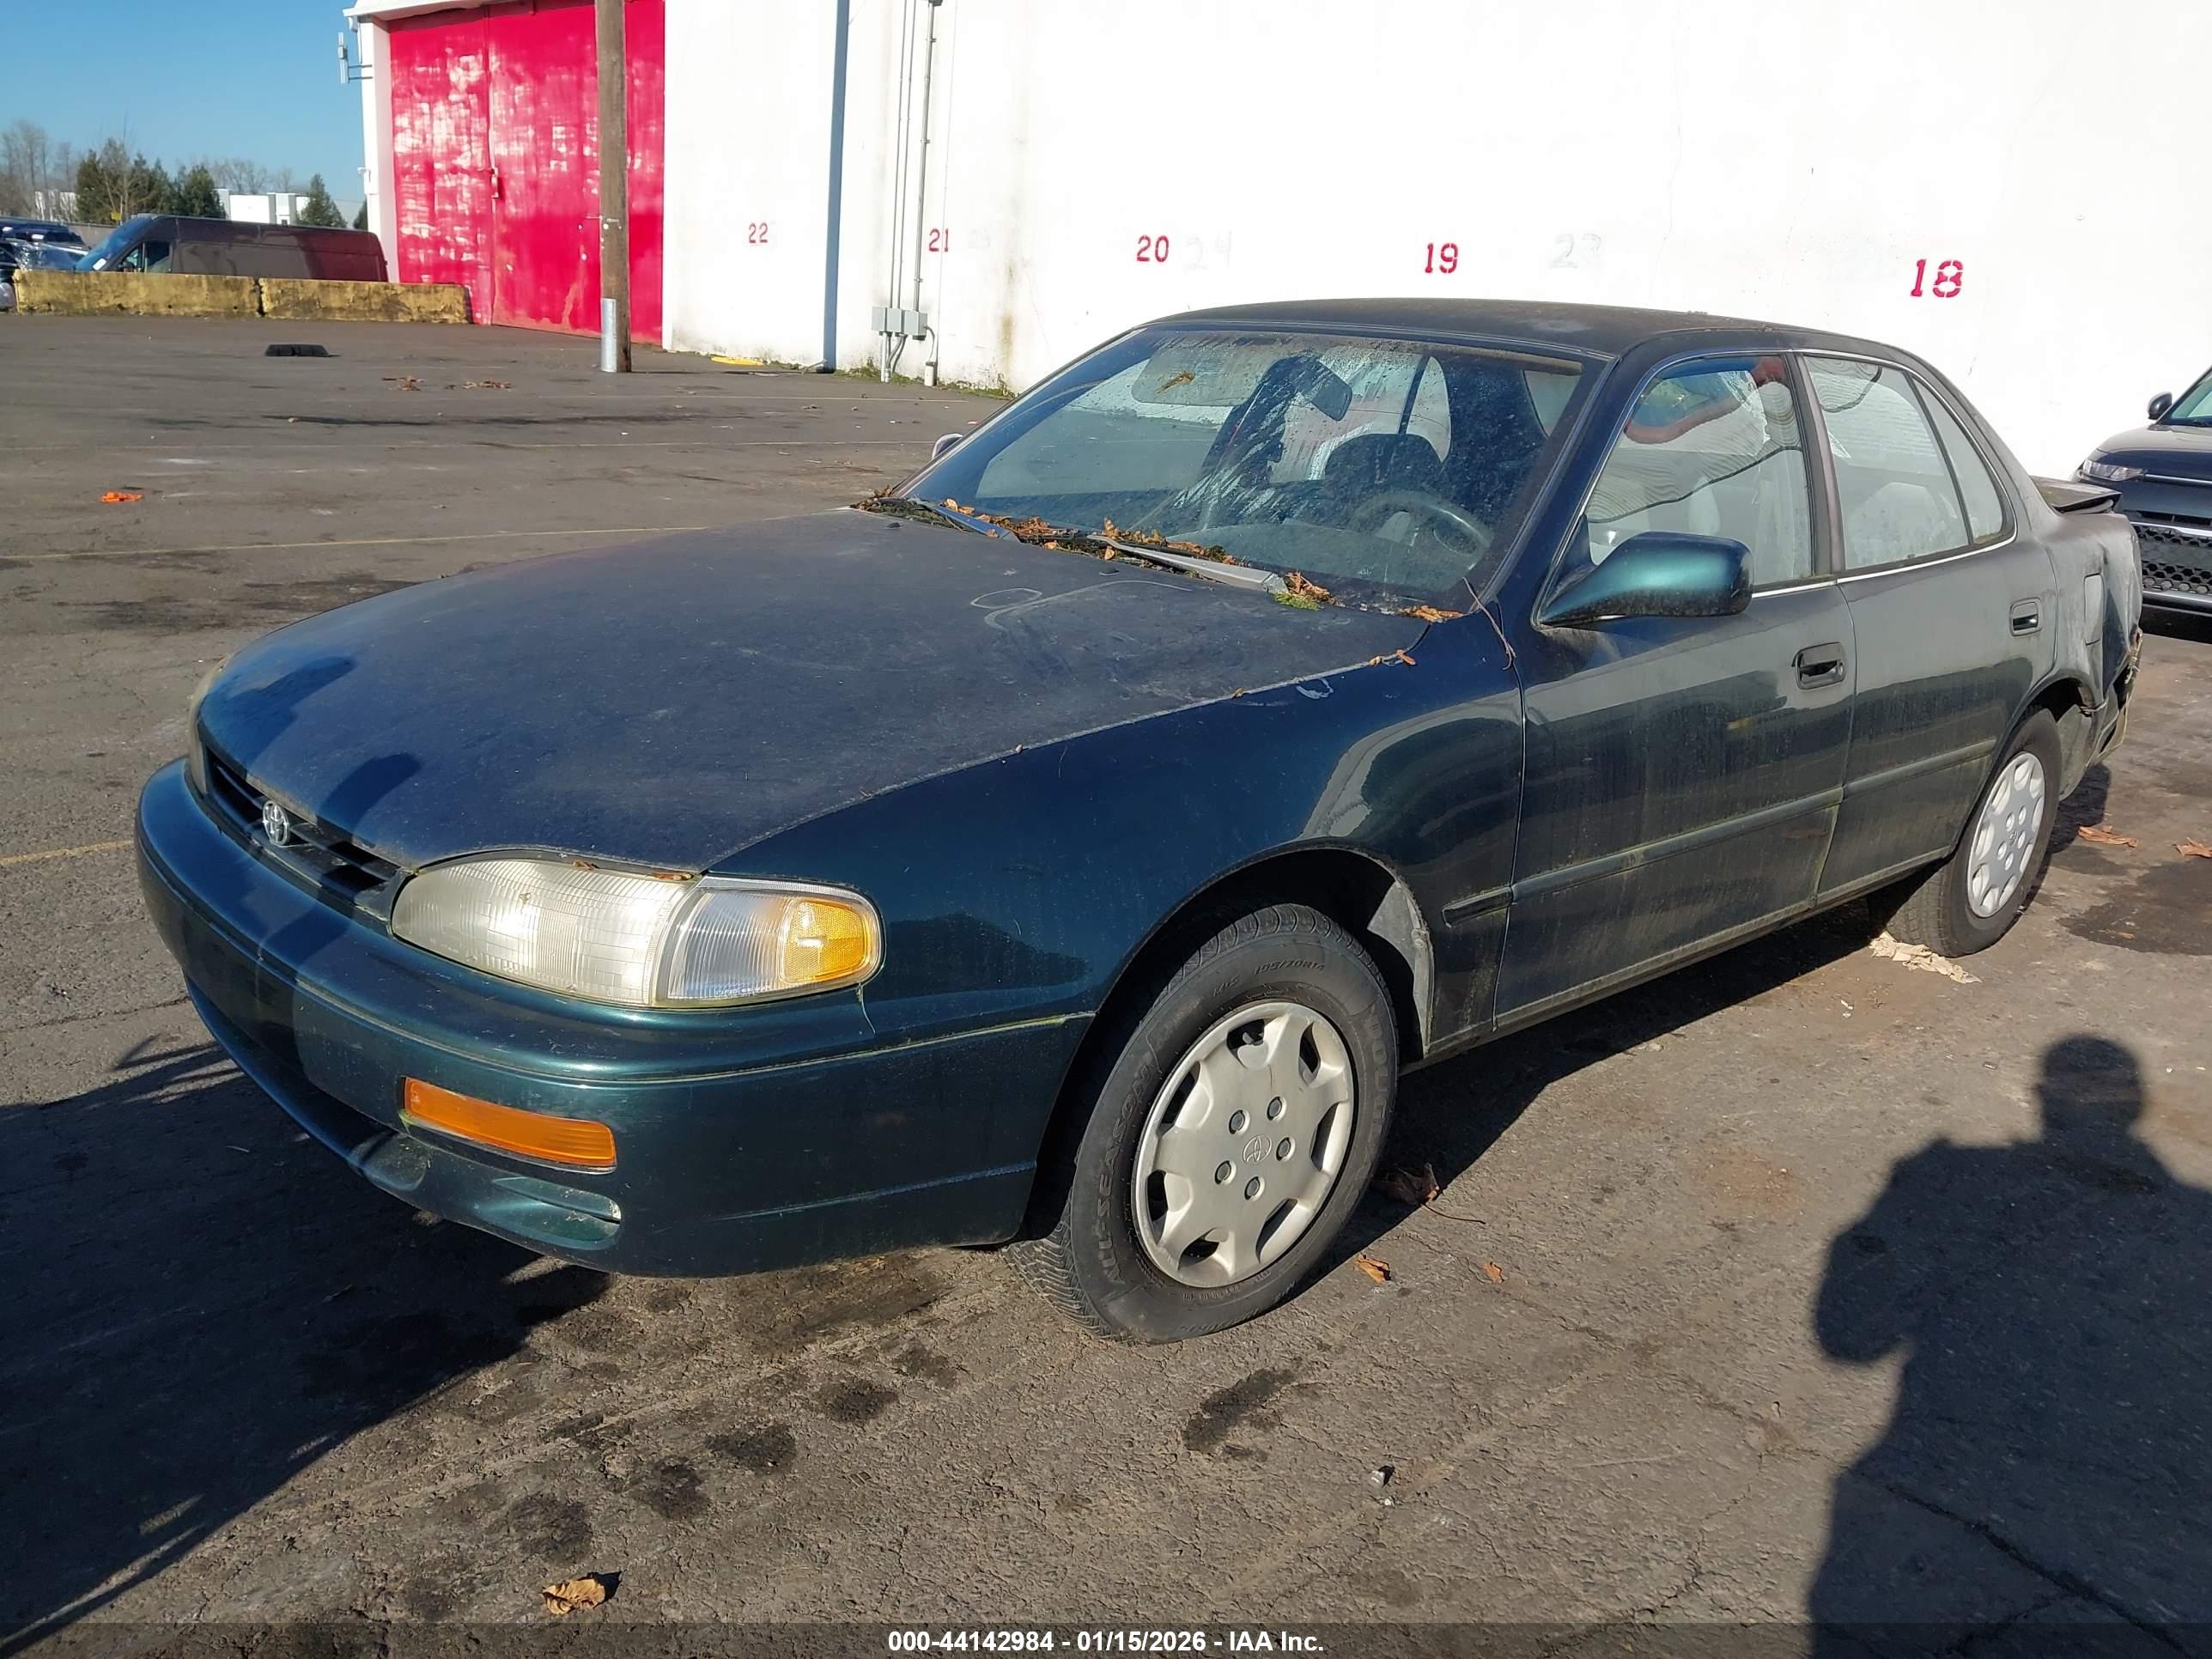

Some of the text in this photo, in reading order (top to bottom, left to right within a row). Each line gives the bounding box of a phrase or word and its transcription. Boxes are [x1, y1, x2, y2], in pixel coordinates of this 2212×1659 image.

[748, 222, 769, 244] 22
[928, 228, 950, 252] 21
[1136, 234, 1170, 263] 20
[1424, 242, 1459, 274] 19
[1909, 258, 1964, 298] 18
